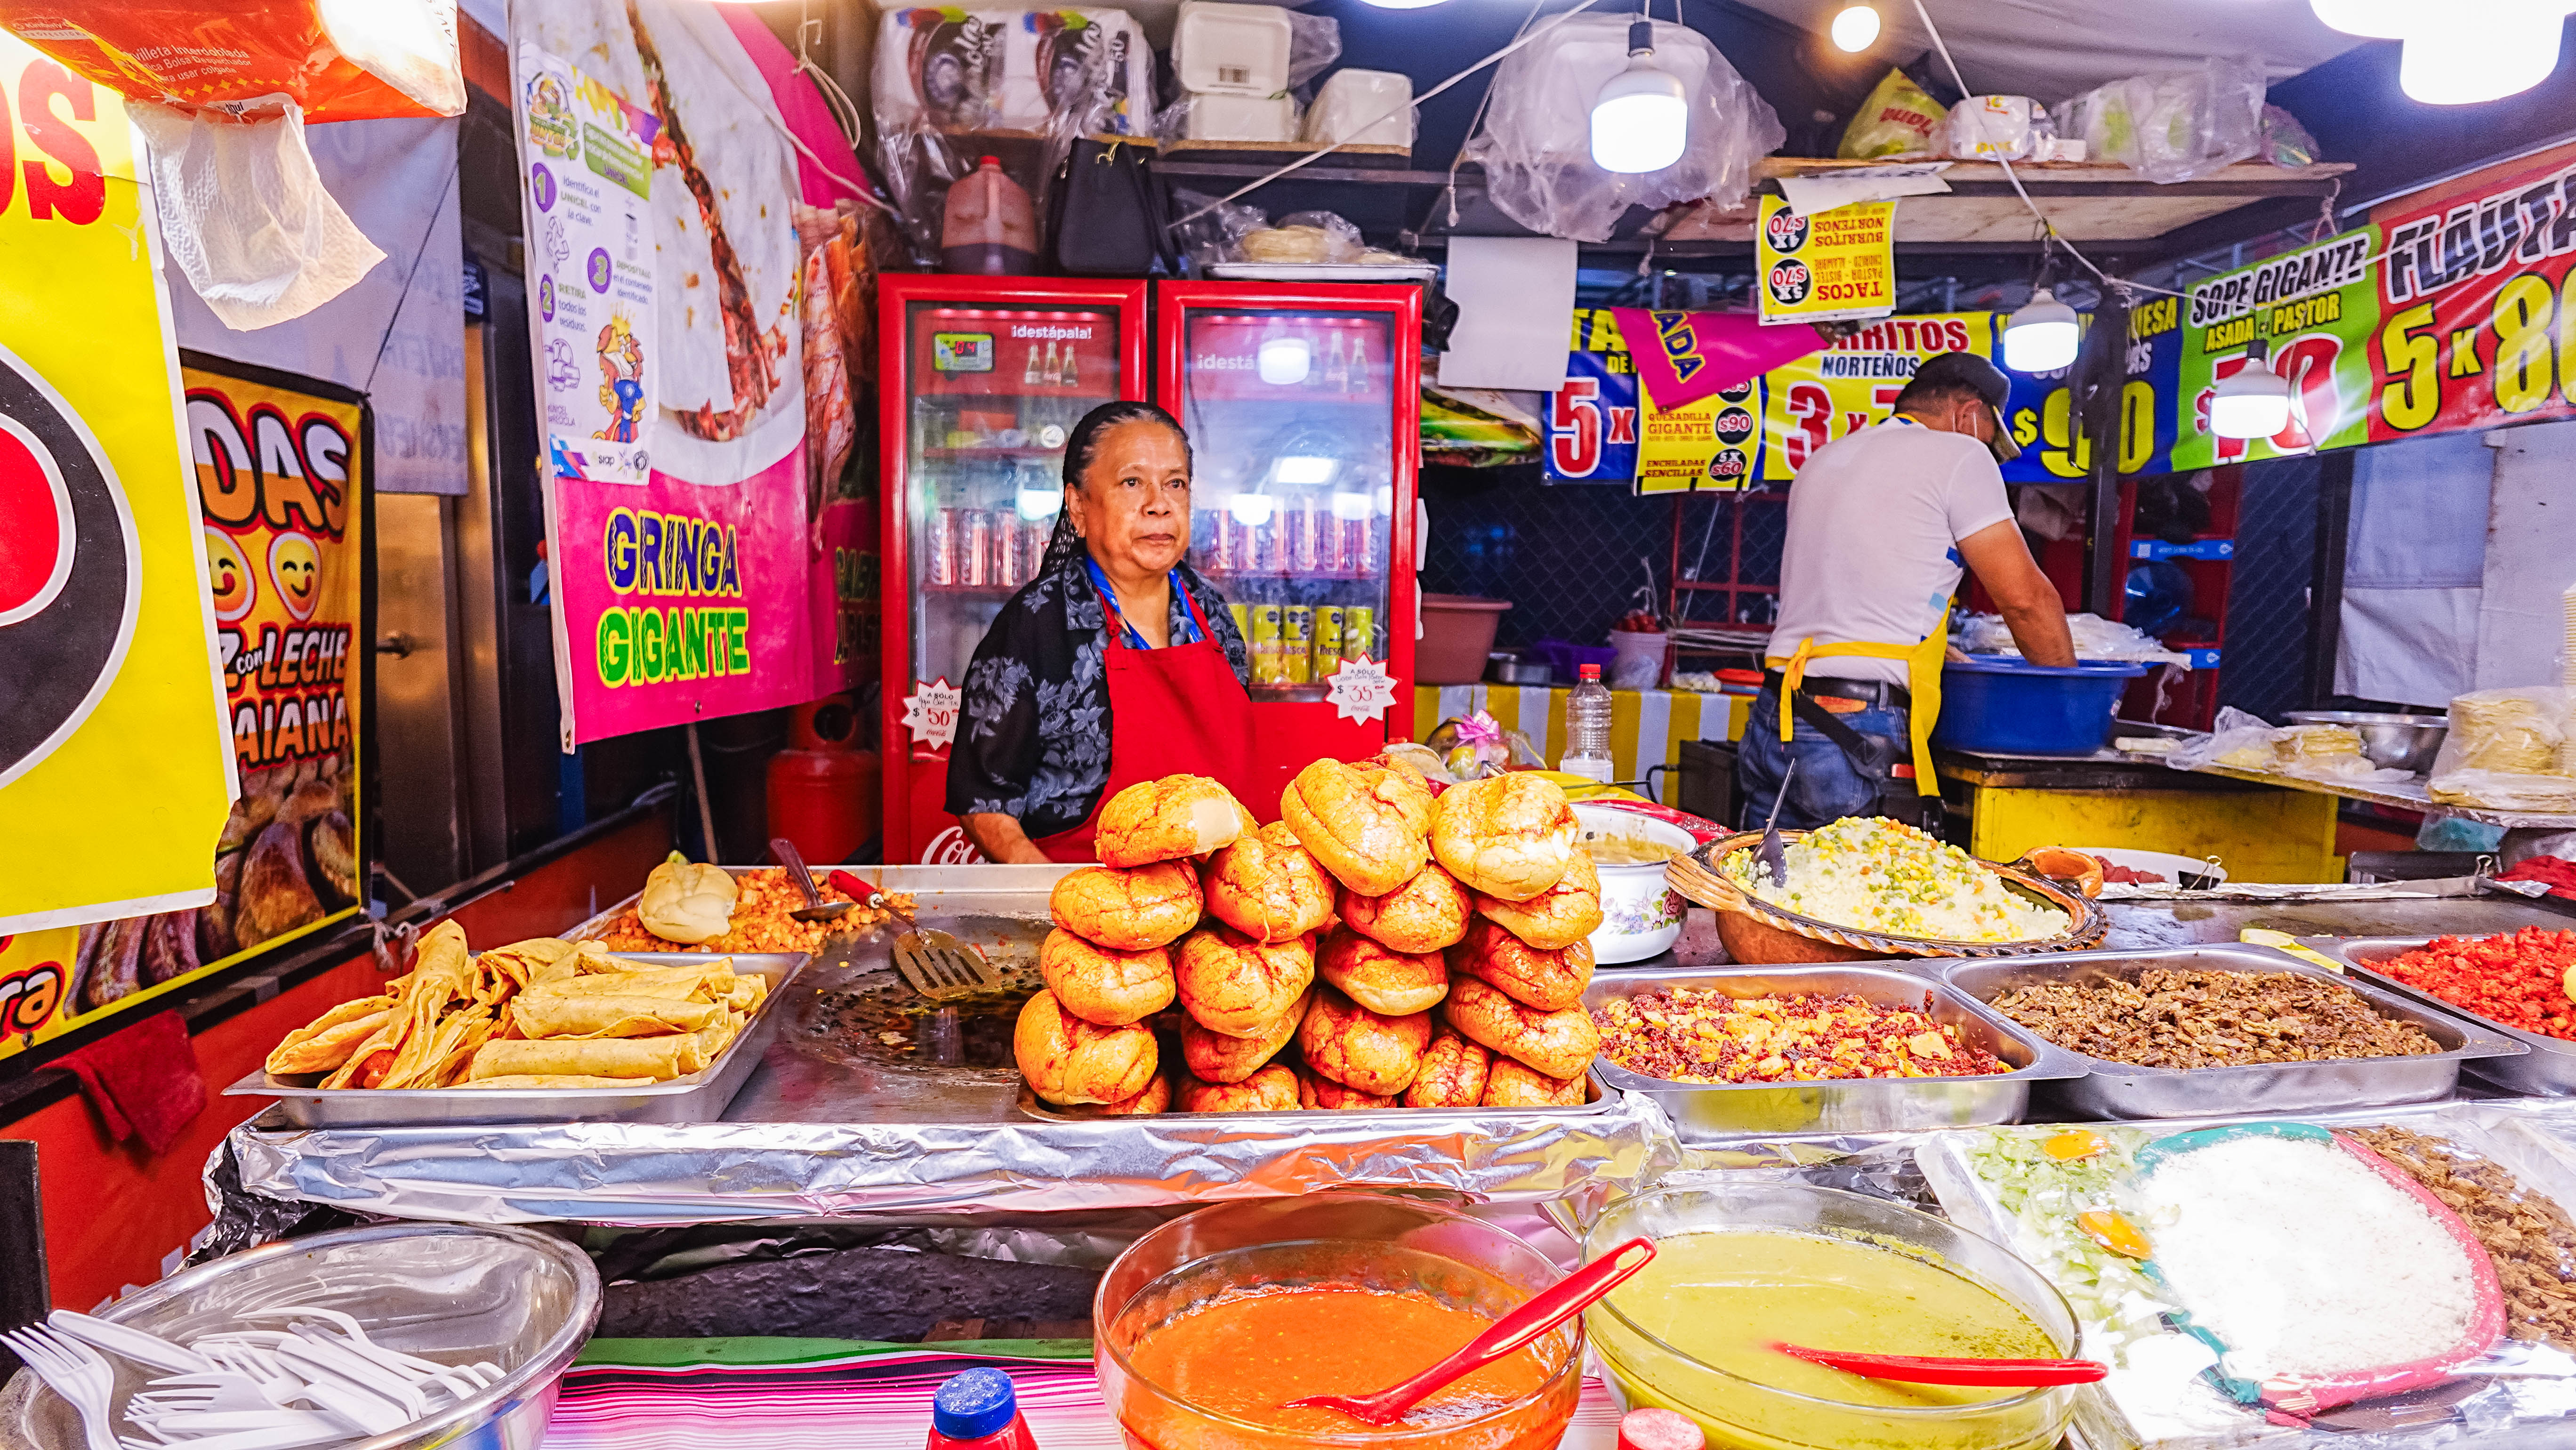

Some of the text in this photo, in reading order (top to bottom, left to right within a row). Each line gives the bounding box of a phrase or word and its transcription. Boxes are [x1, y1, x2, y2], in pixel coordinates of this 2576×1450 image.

[131, 45, 250, 61] villeta Interdoblada
[163, 56, 190, 69] Bolsa
[192, 56, 252, 66] Despachador
[177, 70, 198, 81] usar
[0, 57, 106, 226] S
[535, 171, 546, 204] 1
[563, 175, 593, 196] Identifica
[568, 208, 574, 219] la
[590, 204, 601, 214] con
[1815, 232, 1884, 247] BURRITOS
[593, 256, 608, 286] 3
[2190, 233, 2371, 327] SOPE GIGANTE
[542, 282, 552, 314] 2
[1817, 281, 1883, 301] TACOS
[558, 299, 577, 314] todos
[2204, 291, 2342, 354] ASADA PASTOR
[1827, 318, 1971, 353] RITOS
[1606, 355, 1629, 373] DE
[1820, 353, 1921, 379] NORTEÑOS
[2380, 299, 2442, 433] 5
[1552, 377, 1601, 478] 5
[1648, 423, 1711, 434] GIGANTE
[1785, 380, 1835, 475] 3
[185, 393, 350, 537] DAS
[1645, 468, 1704, 477] SENCILLAS
[1647, 459, 1706, 467] ENCHILADAS
[604, 506, 743, 597] GRINGA
[236, 647, 264, 675] con
[259, 627, 350, 689] LECHE
[596, 605, 751, 689] GIGANTE
[1337, 685, 1373, 703] $ 35
[913, 707, 950, 726] $ 50
